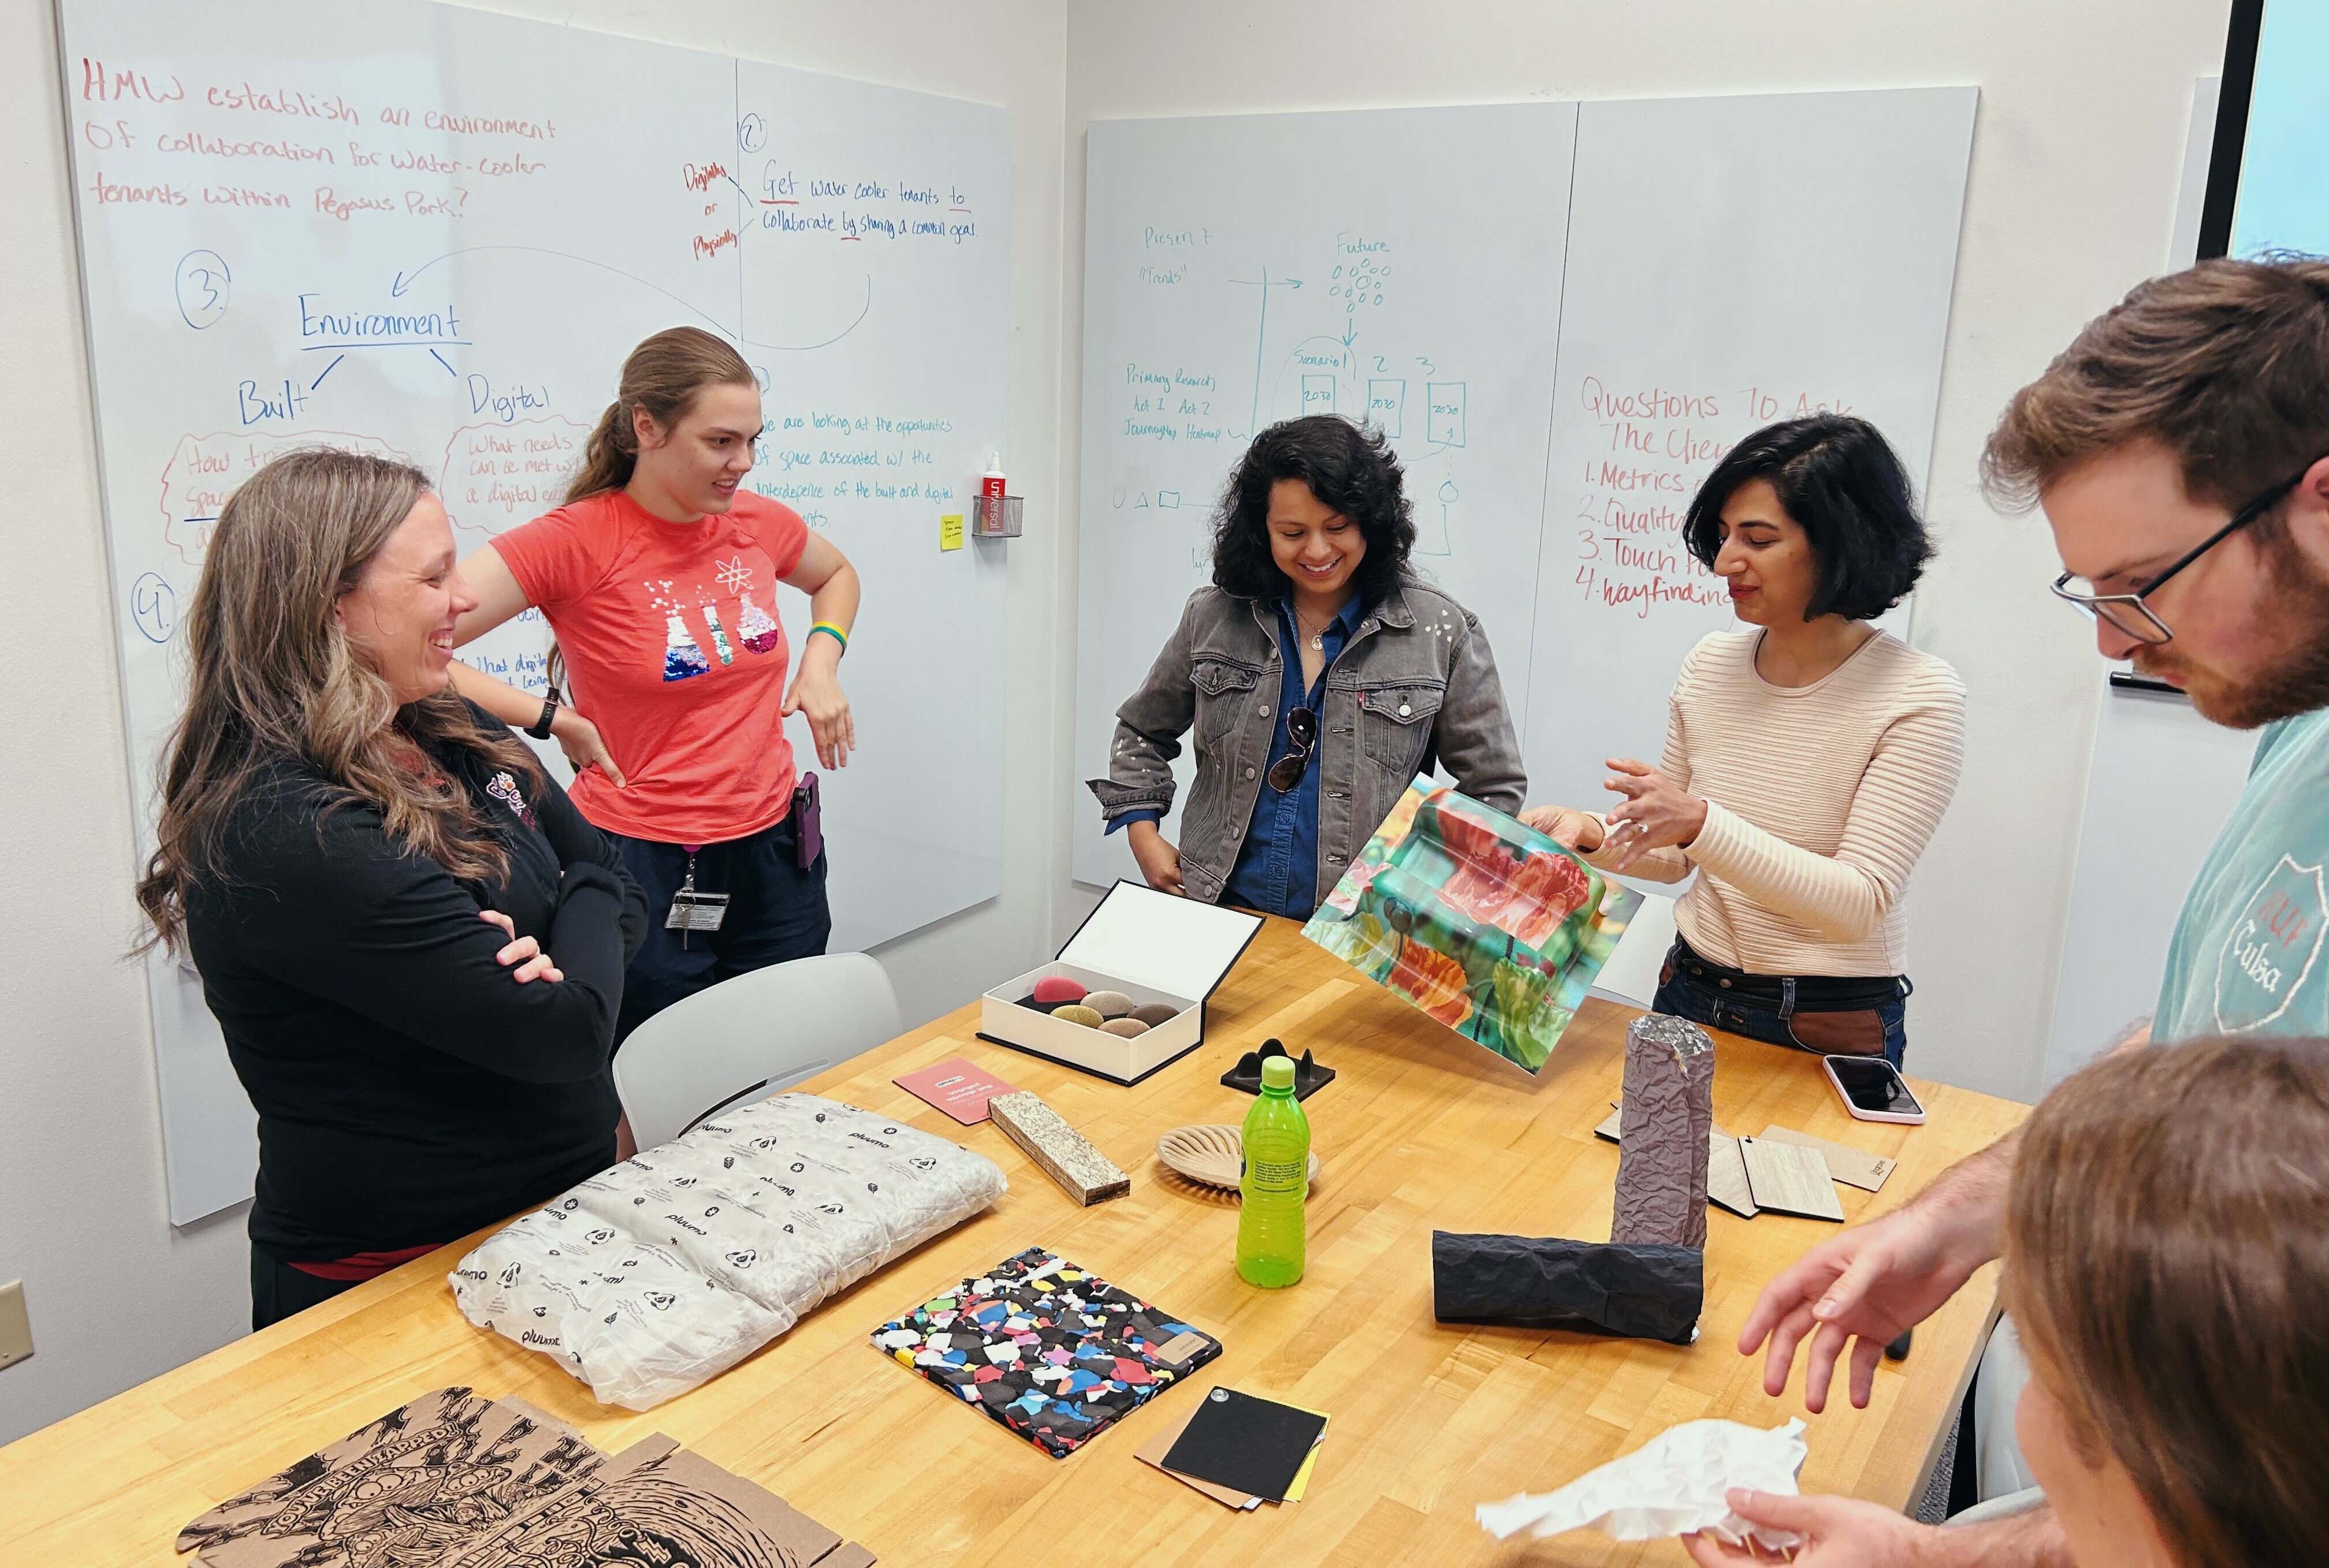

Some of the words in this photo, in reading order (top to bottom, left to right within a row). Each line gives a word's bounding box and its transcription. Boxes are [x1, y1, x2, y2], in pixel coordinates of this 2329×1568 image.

[83, 58, 184, 102] HMW
[207, 83, 359, 125] establish
[380, 106, 410, 126] an
[425, 109, 556, 140] environment
[157, 133, 334, 165] collaboration
[349, 141, 380, 167] for
[88, 171, 188, 206] tenants
[314, 186, 395, 221] Pegasus
[762, 159, 799, 195] Get
[898, 185, 940, 204] tenants
[950, 186, 966, 206] to
[704, 202, 719, 216] or
[841, 215, 857, 236] by
[860, 214, 895, 239] sharing
[898, 218, 907, 234] a
[911, 219, 946, 236] common
[1336, 232, 1390, 255] Future
[297, 293, 462, 337] Environment
[1127, 363, 1170, 393] Primary
[1373, 356, 1389, 373] 2
[1415, 356, 1435, 376] 3
[238, 379, 309, 425] Built
[467, 373, 550, 422] Digital
[1178, 398, 1197, 415] Act
[1304, 390, 1331, 403] 2030
[1371, 398, 1396, 411] 2030
[1433, 403, 1459, 416] 2030
[1582, 376, 1719, 420] Questions
[784, 417, 804, 430] are
[812, 411, 851, 435] looking
[855, 416, 869, 431] at
[876, 416, 893, 433] the
[896, 417, 953, 437] opportunities
[468, 434, 516, 456] What
[523, 433, 572, 453] needs
[1601, 421, 1659, 455] The
[1666, 427, 1735, 465] Clien
[184, 443, 230, 476] How
[470, 460, 496, 476] can
[524, 458, 552, 473] met
[779, 450, 812, 472] space
[820, 448, 880, 467] associated
[912, 446, 933, 465] the
[1599, 463, 1684, 492] Metrics
[186, 486, 228, 518] Spac
[466, 488, 479, 504] a
[488, 480, 537, 513] digital
[834, 481, 847, 497] of
[855, 481, 871, 499] the
[899, 485, 920, 499] and
[924, 485, 954, 505] digital
[988, 481, 1002, 530] universal
[1604, 497, 1685, 548] Quality
[1603, 537, 1676, 572] Touch
[515, 653, 547, 673] digita
[848, 1132, 889, 1149] pluumo
[665, 1214, 706, 1236] pluumo
[329, 1458, 374, 1489] BEEN
